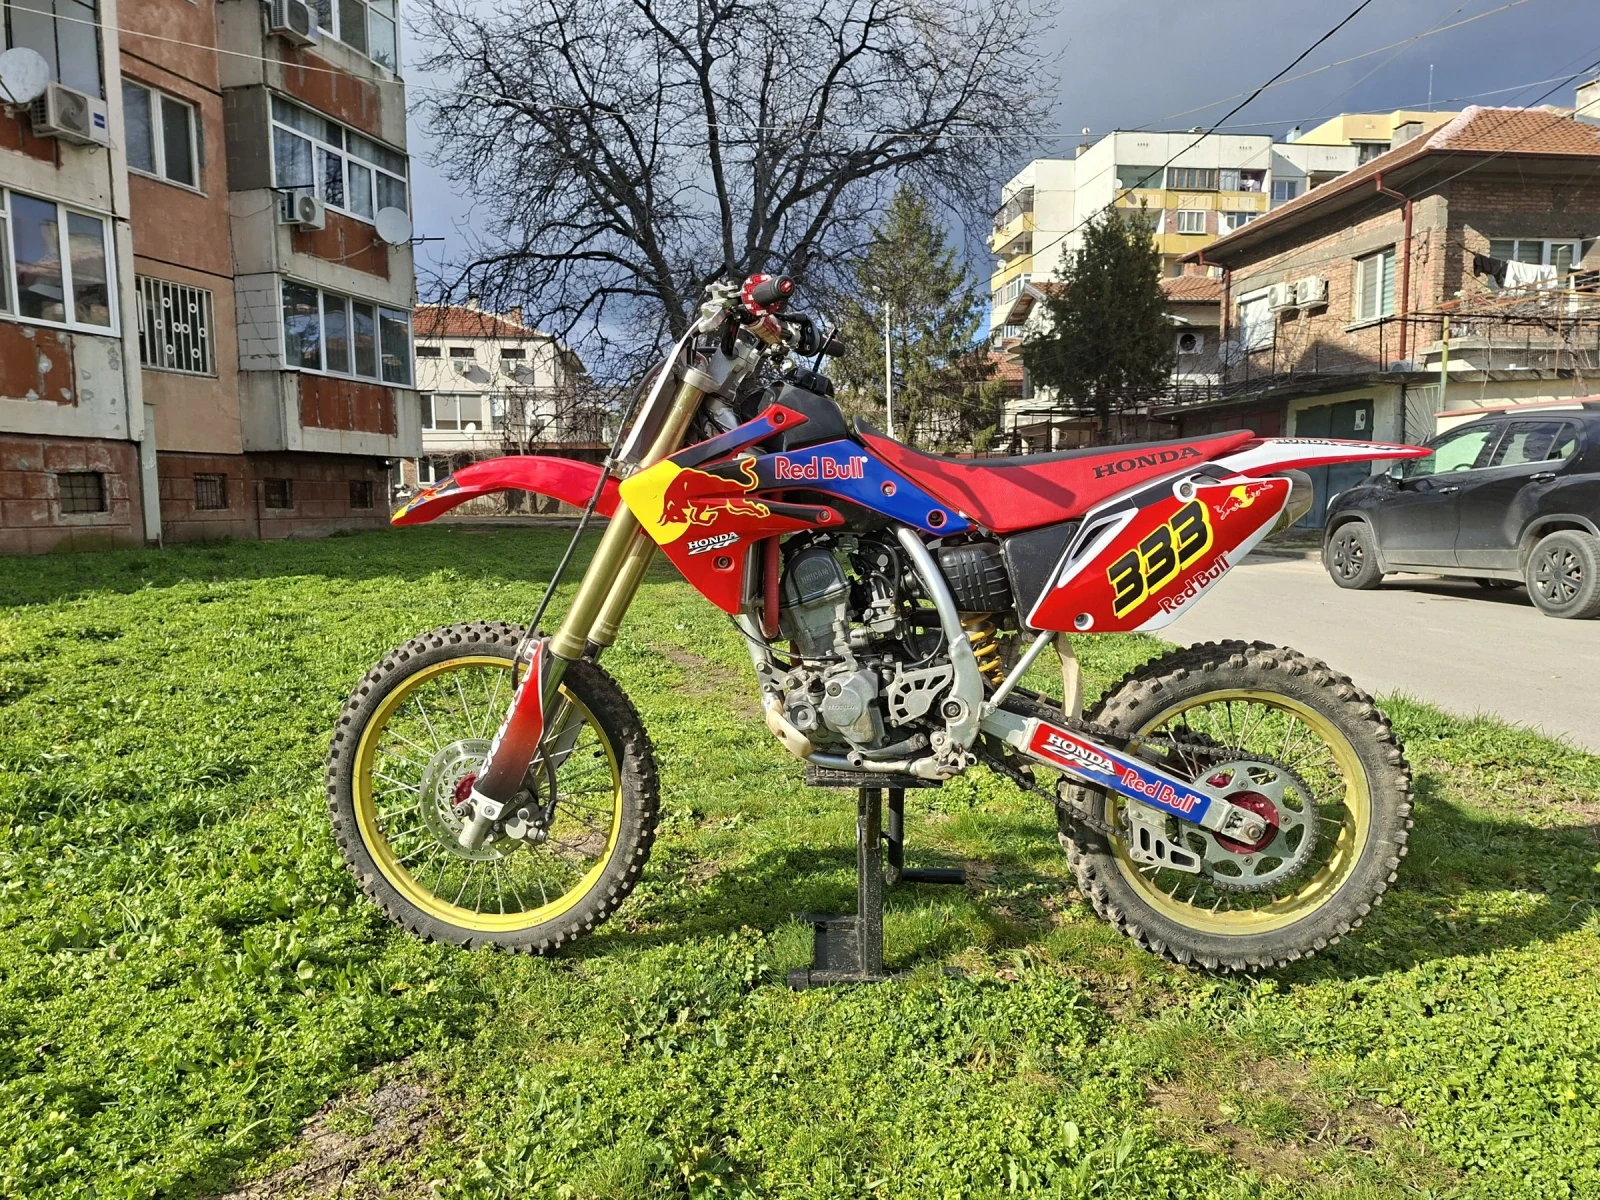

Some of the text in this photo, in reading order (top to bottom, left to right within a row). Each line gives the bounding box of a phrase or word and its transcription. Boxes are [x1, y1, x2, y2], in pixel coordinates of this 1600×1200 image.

[775, 456, 864, 479] Red Bull
[1092, 446, 1204, 480] HONDA
[687, 531, 741, 549] HONDA
[1107, 498, 1213, 619] 333
[1158, 553, 1230, 614] Red Bull
[1046, 733, 1115, 773] HONDA
[1121, 768, 1197, 813] Red Bull
